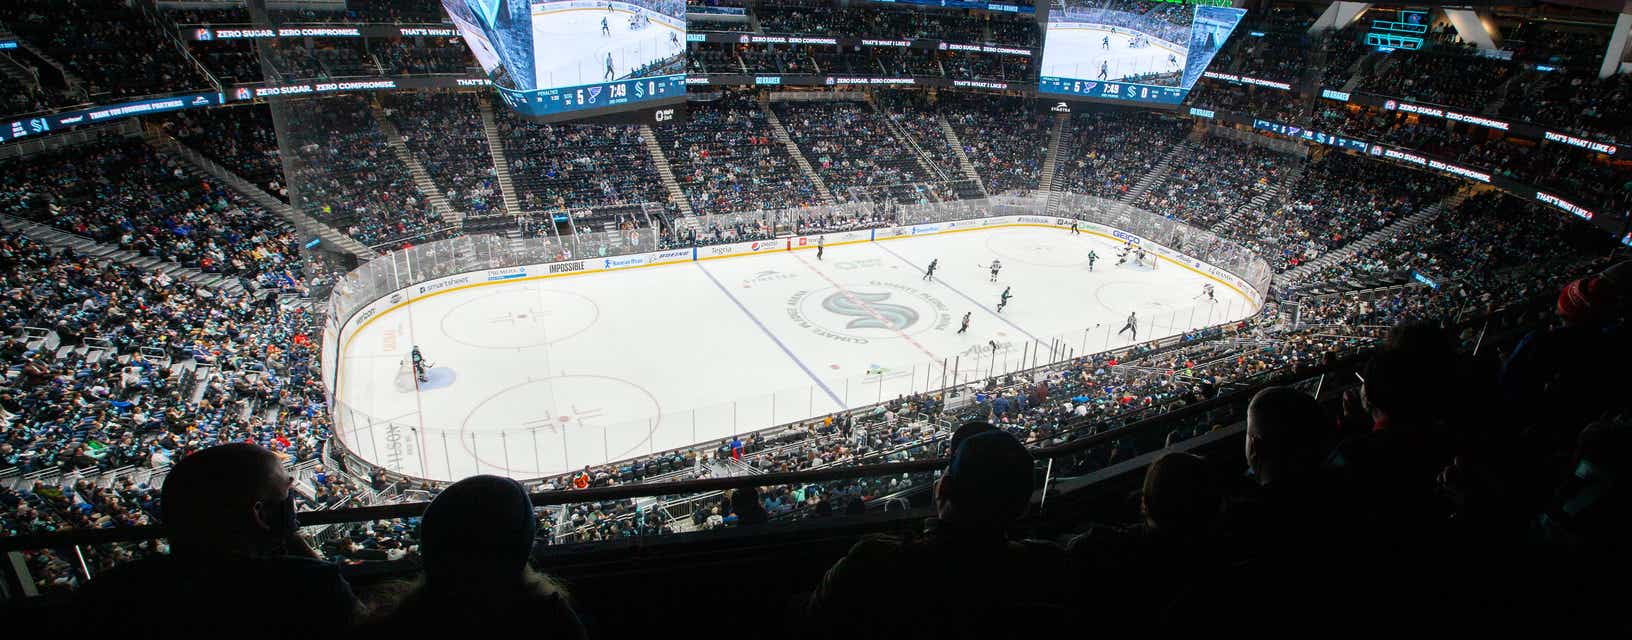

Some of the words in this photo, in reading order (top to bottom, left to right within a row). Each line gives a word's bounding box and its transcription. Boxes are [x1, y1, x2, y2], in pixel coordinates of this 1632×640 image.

[216, 30, 241, 38] ZERO
[242, 29, 276, 37] SUGAR.
[301, 28, 360, 36] COMPROMISE.
[400, 28, 427, 36] THAT'S
[428, 28, 449, 36] WHAT
[256, 88, 279, 96] ZERO
[280, 85, 312, 94] SUGAR.
[316, 83, 337, 91] ZERO
[339, 81, 396, 89] COMPROMISE.
[610, 83, 626, 98] 7:49
[649, 81, 655, 96] 0
[1074, 81, 1080, 92] 5
[1104, 83, 1119, 94] 7:49
[1141, 87, 1147, 98] 0
[577, 89, 584, 105] 5
[1399, 103, 1417, 112] ZERO
[1446, 112, 1463, 120] ZERO
[1545, 131, 1567, 142] THAT'S
[1567, 136, 1588, 148] WHAT
[1592, 143, 1610, 153] LIKE
[1385, 149, 1403, 159] ZERO
[1428, 160, 1446, 170] ZERO
[1536, 191, 1559, 205] THAT'S
[1559, 200, 1574, 211] WHAT
[1576, 207, 1588, 218] LIKE
[1113, 230, 1140, 244] GEICO
[549, 262, 585, 273] IMPOSSIBLE
[427, 277, 469, 290] smartsheet
[812, 328, 869, 344] CLIMATE
